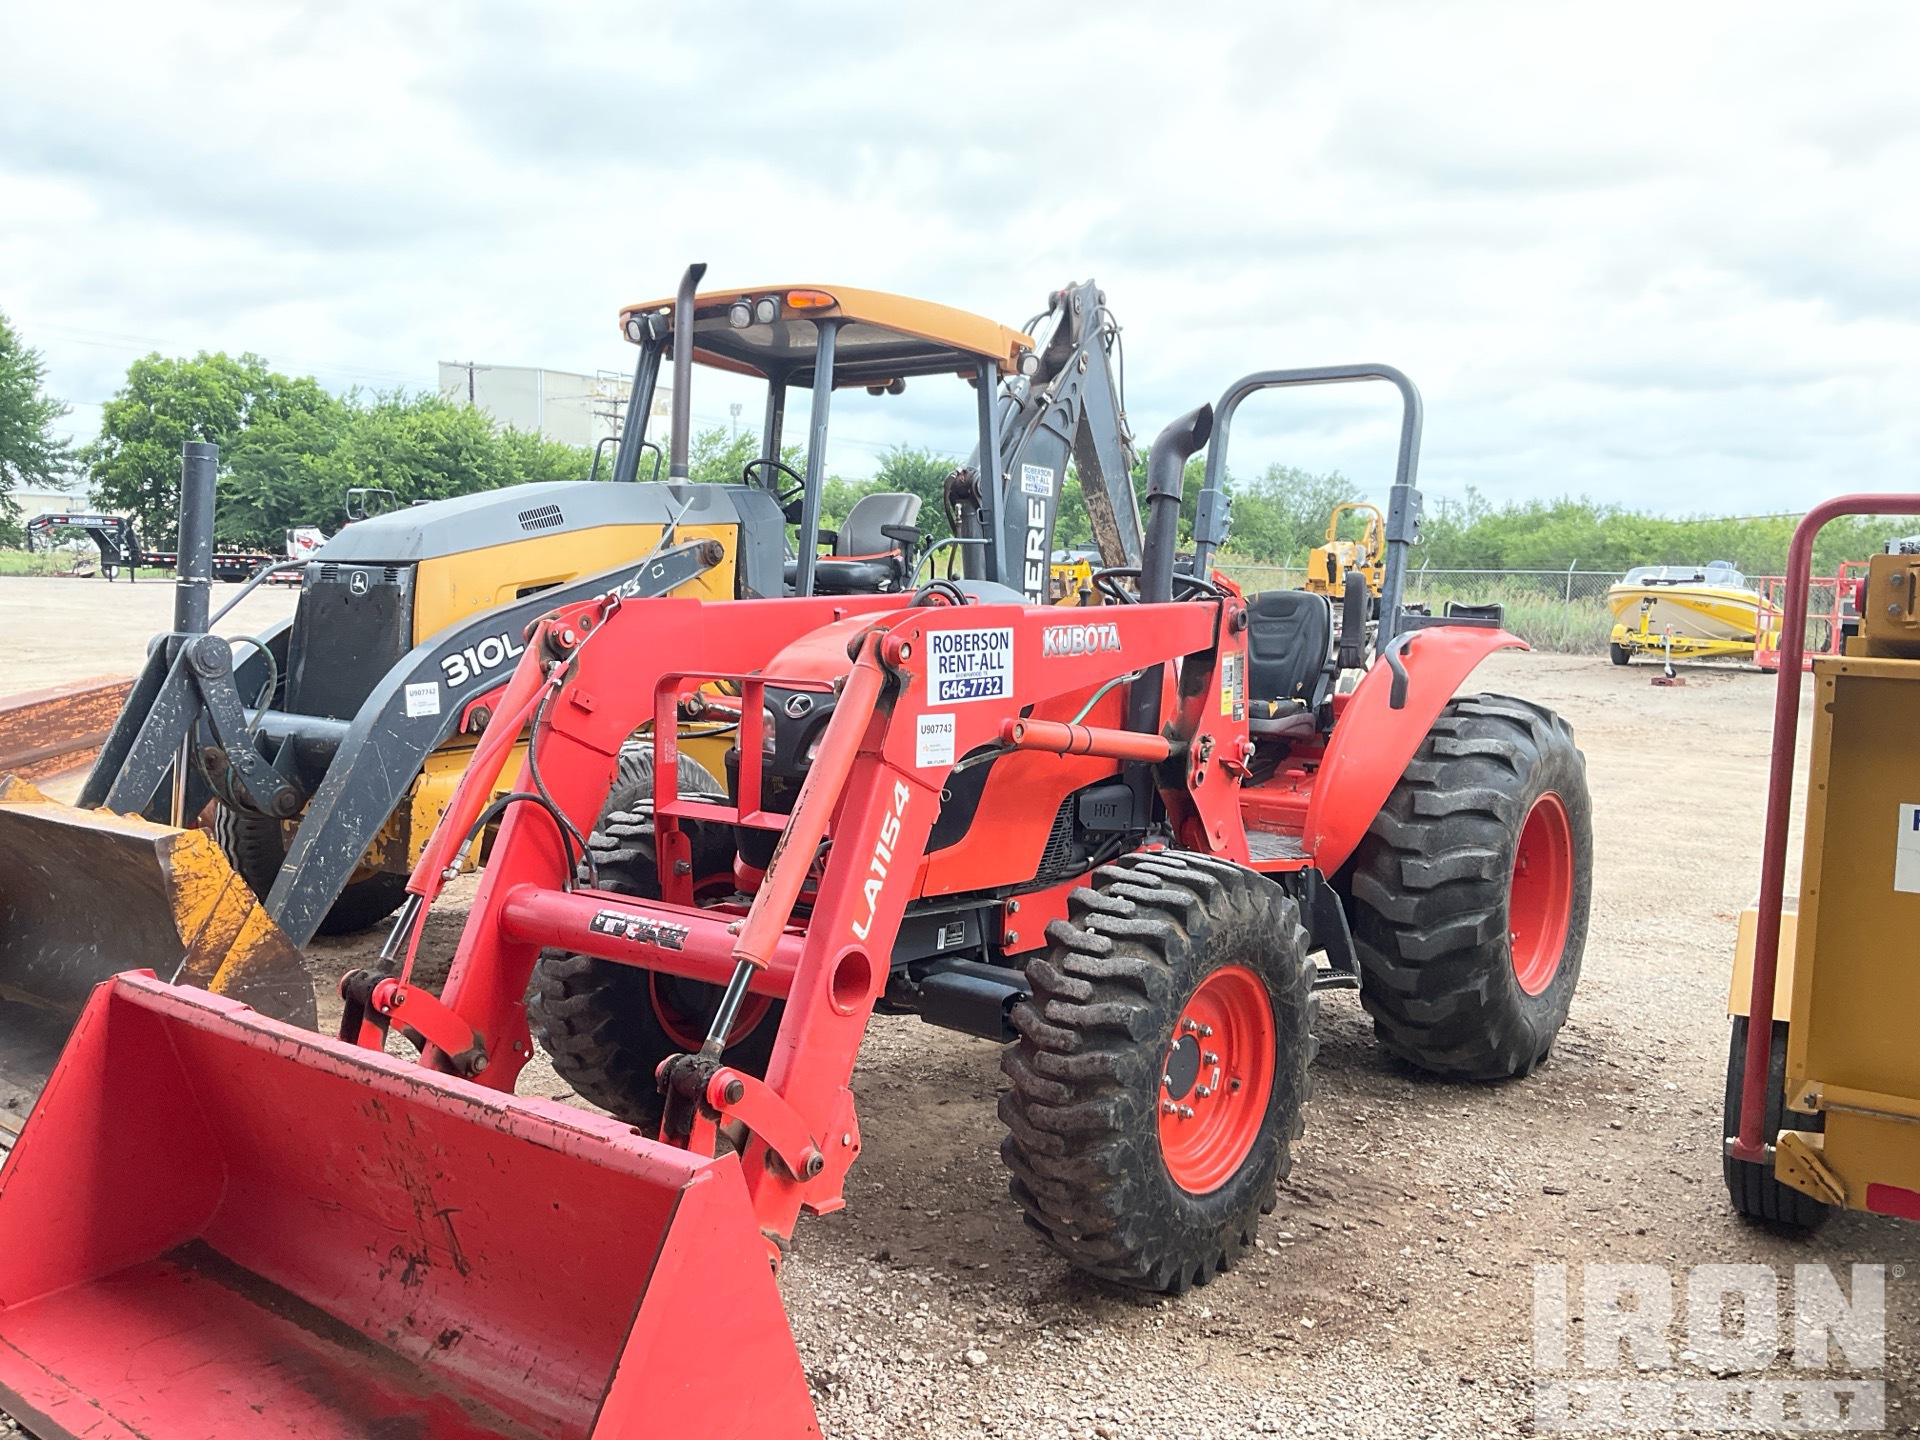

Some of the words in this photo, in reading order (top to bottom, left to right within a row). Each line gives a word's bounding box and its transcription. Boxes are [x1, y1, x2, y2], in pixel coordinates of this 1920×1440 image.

[933, 632, 1009, 654] ROBERSON
[1043, 624, 1121, 656] KUBOTA
[440, 632, 525, 688] 310L
[939, 652, 1004, 674] RENT-ALL
[941, 676, 1001, 699] 646-7732
[921, 723, 952, 734] U907743
[1094, 803, 1117, 817] HOT
[851, 780, 910, 940] LA1154
